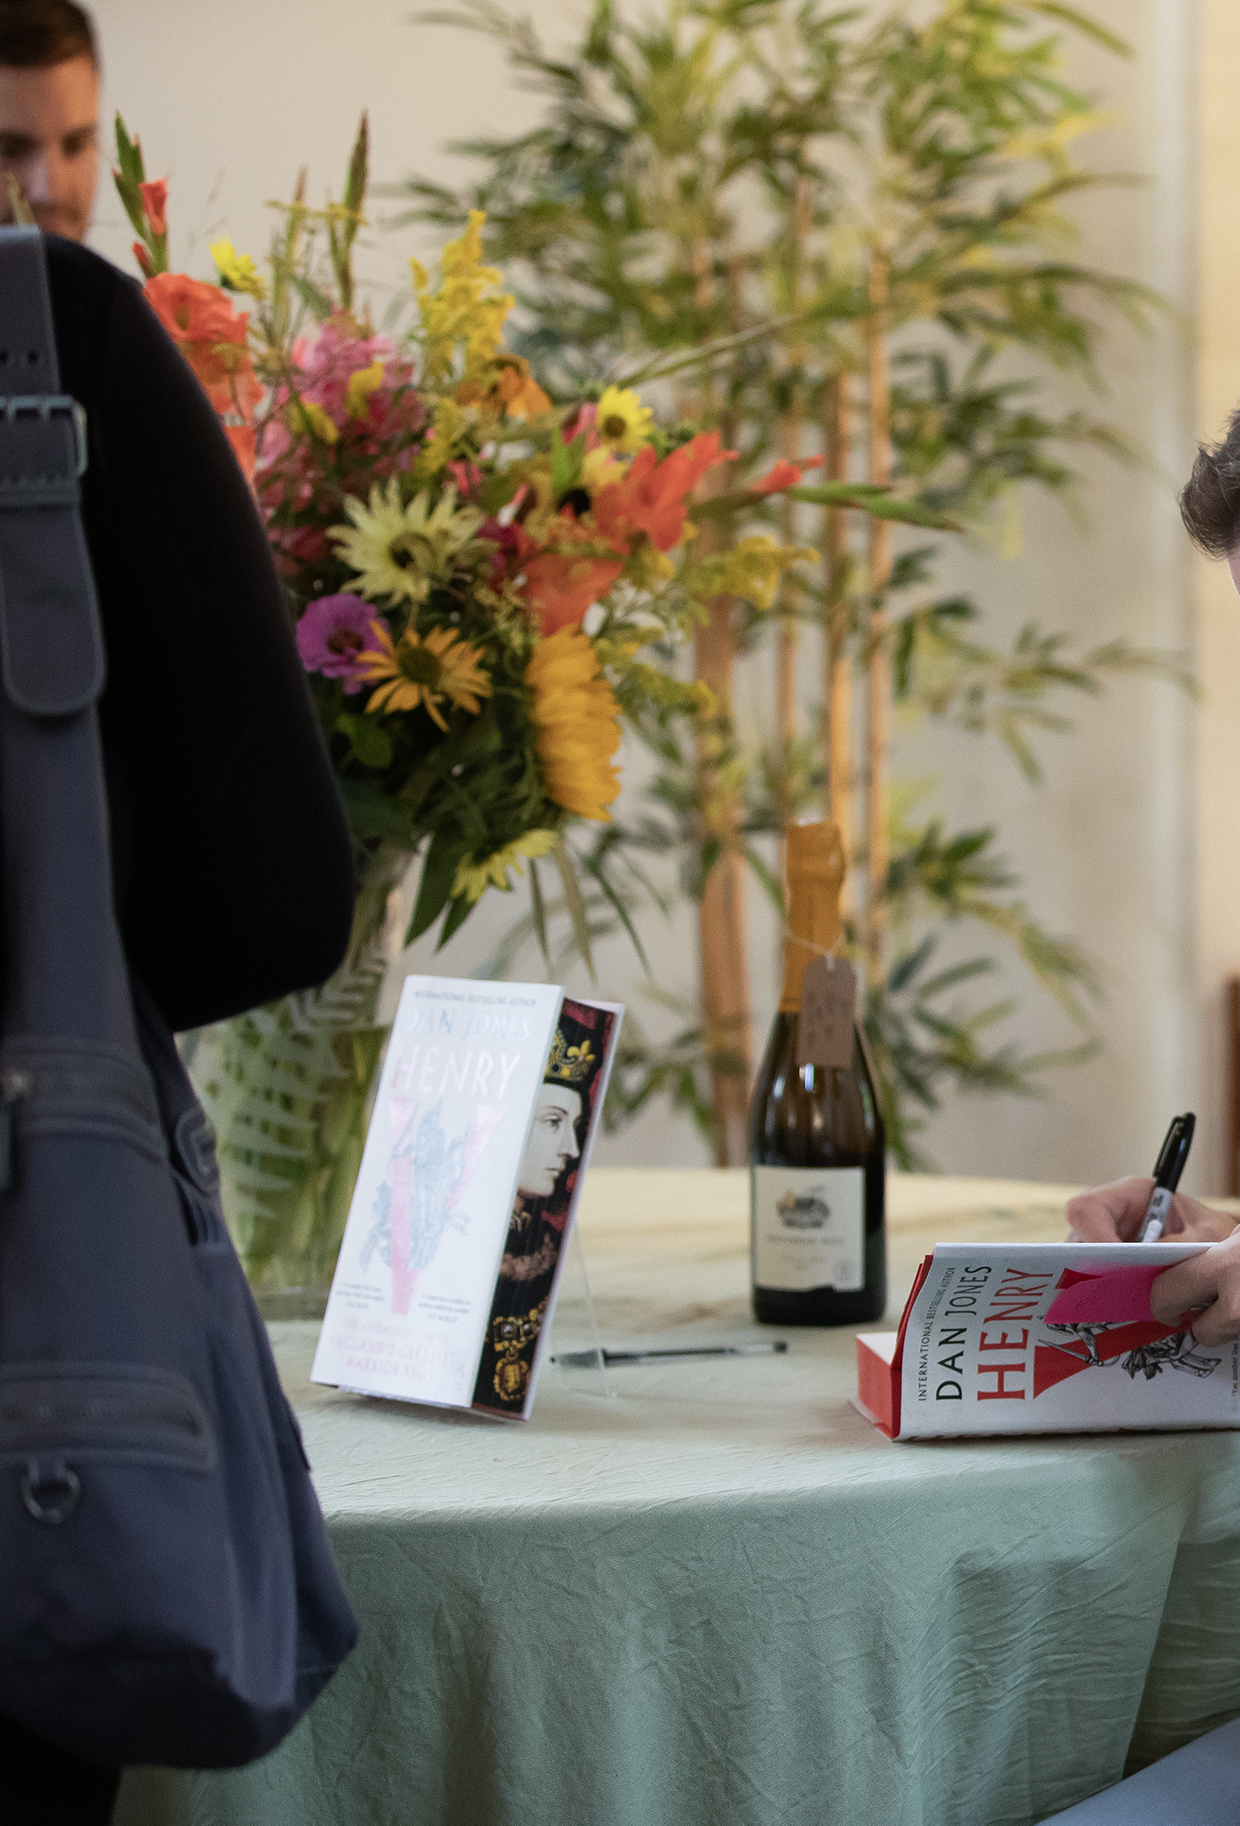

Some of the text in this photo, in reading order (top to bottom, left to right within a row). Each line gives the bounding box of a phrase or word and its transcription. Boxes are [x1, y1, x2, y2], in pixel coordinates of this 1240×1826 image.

[391, 1046, 520, 1100] HENRY
[404, 1008, 532, 1042] DAN JONES
[918, 1266, 956, 1401] INTERNATIONAL BESTSELLING AUTHOR
[936, 1266, 992, 1401] DAN JONES
[977, 1268, 1053, 1401] HENRY
